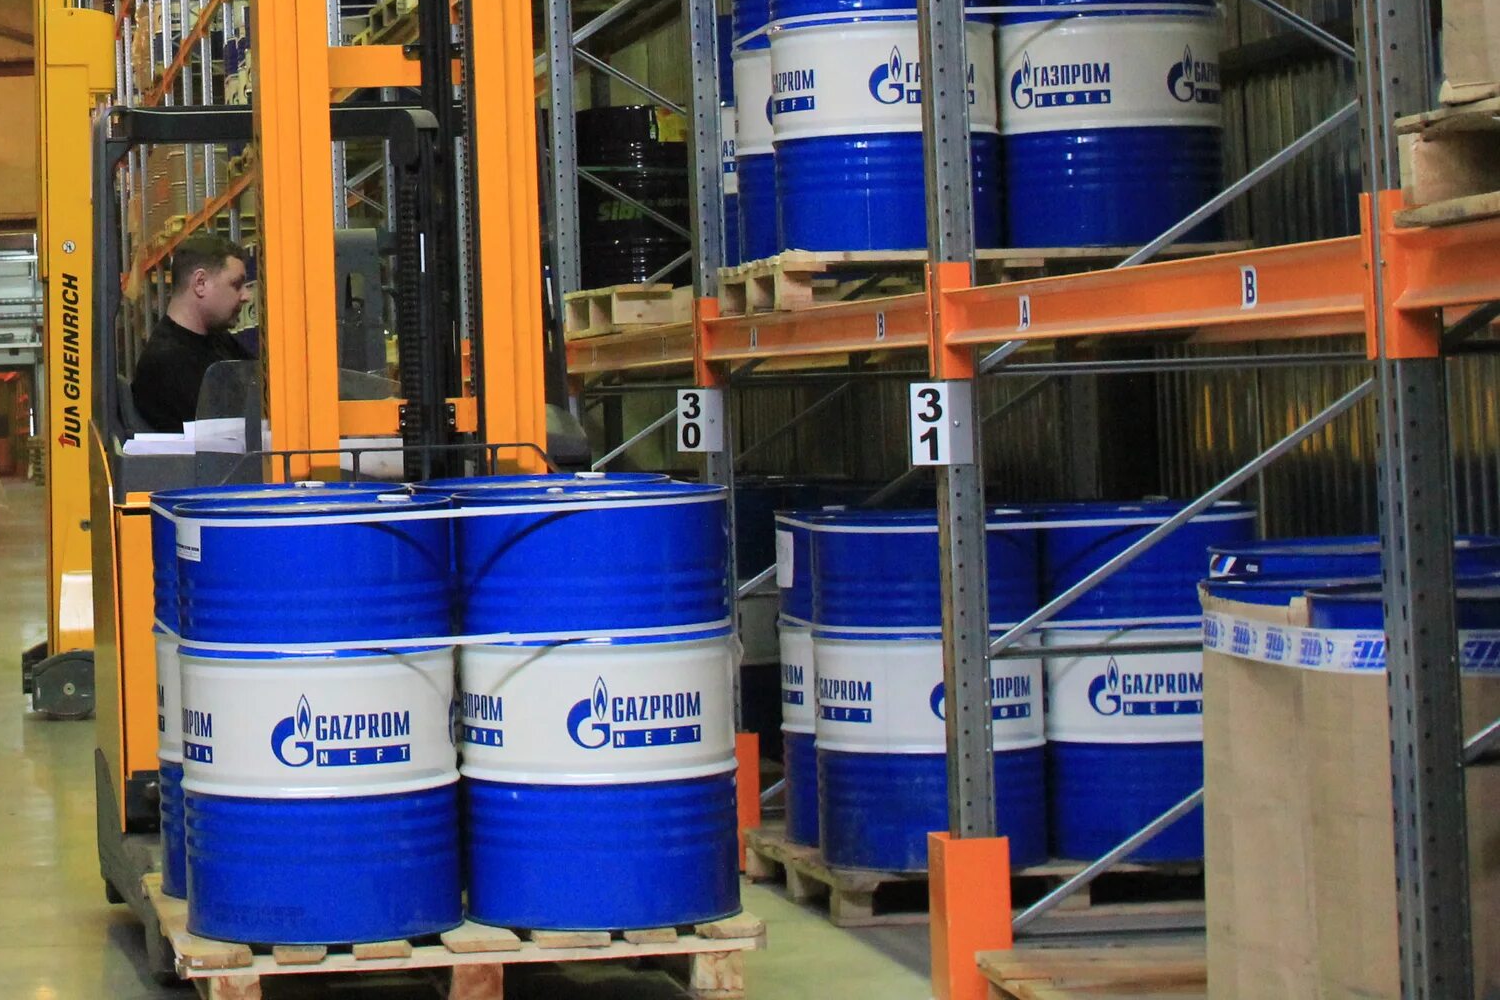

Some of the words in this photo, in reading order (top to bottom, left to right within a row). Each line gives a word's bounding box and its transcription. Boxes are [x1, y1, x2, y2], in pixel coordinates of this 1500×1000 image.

[1034, 63, 1111, 88] ГАЗПРОМ
[781, 98, 812, 111] EFT
[1037, 92, 1108, 106] НЕФТЬ
[1245, 270, 1255, 303] B
[1021, 300, 1029, 326] A
[820, 677, 872, 702] GAZPROM
[1122, 672, 1203, 695] GAZPROM
[612, 691, 701, 722] GAZPROM
[1125, 701, 1202, 714] NEFT
[315, 711, 410, 741] GAZPROM
[616, 727, 699, 746] NEFT
[320, 746, 408, 764] NEFT
